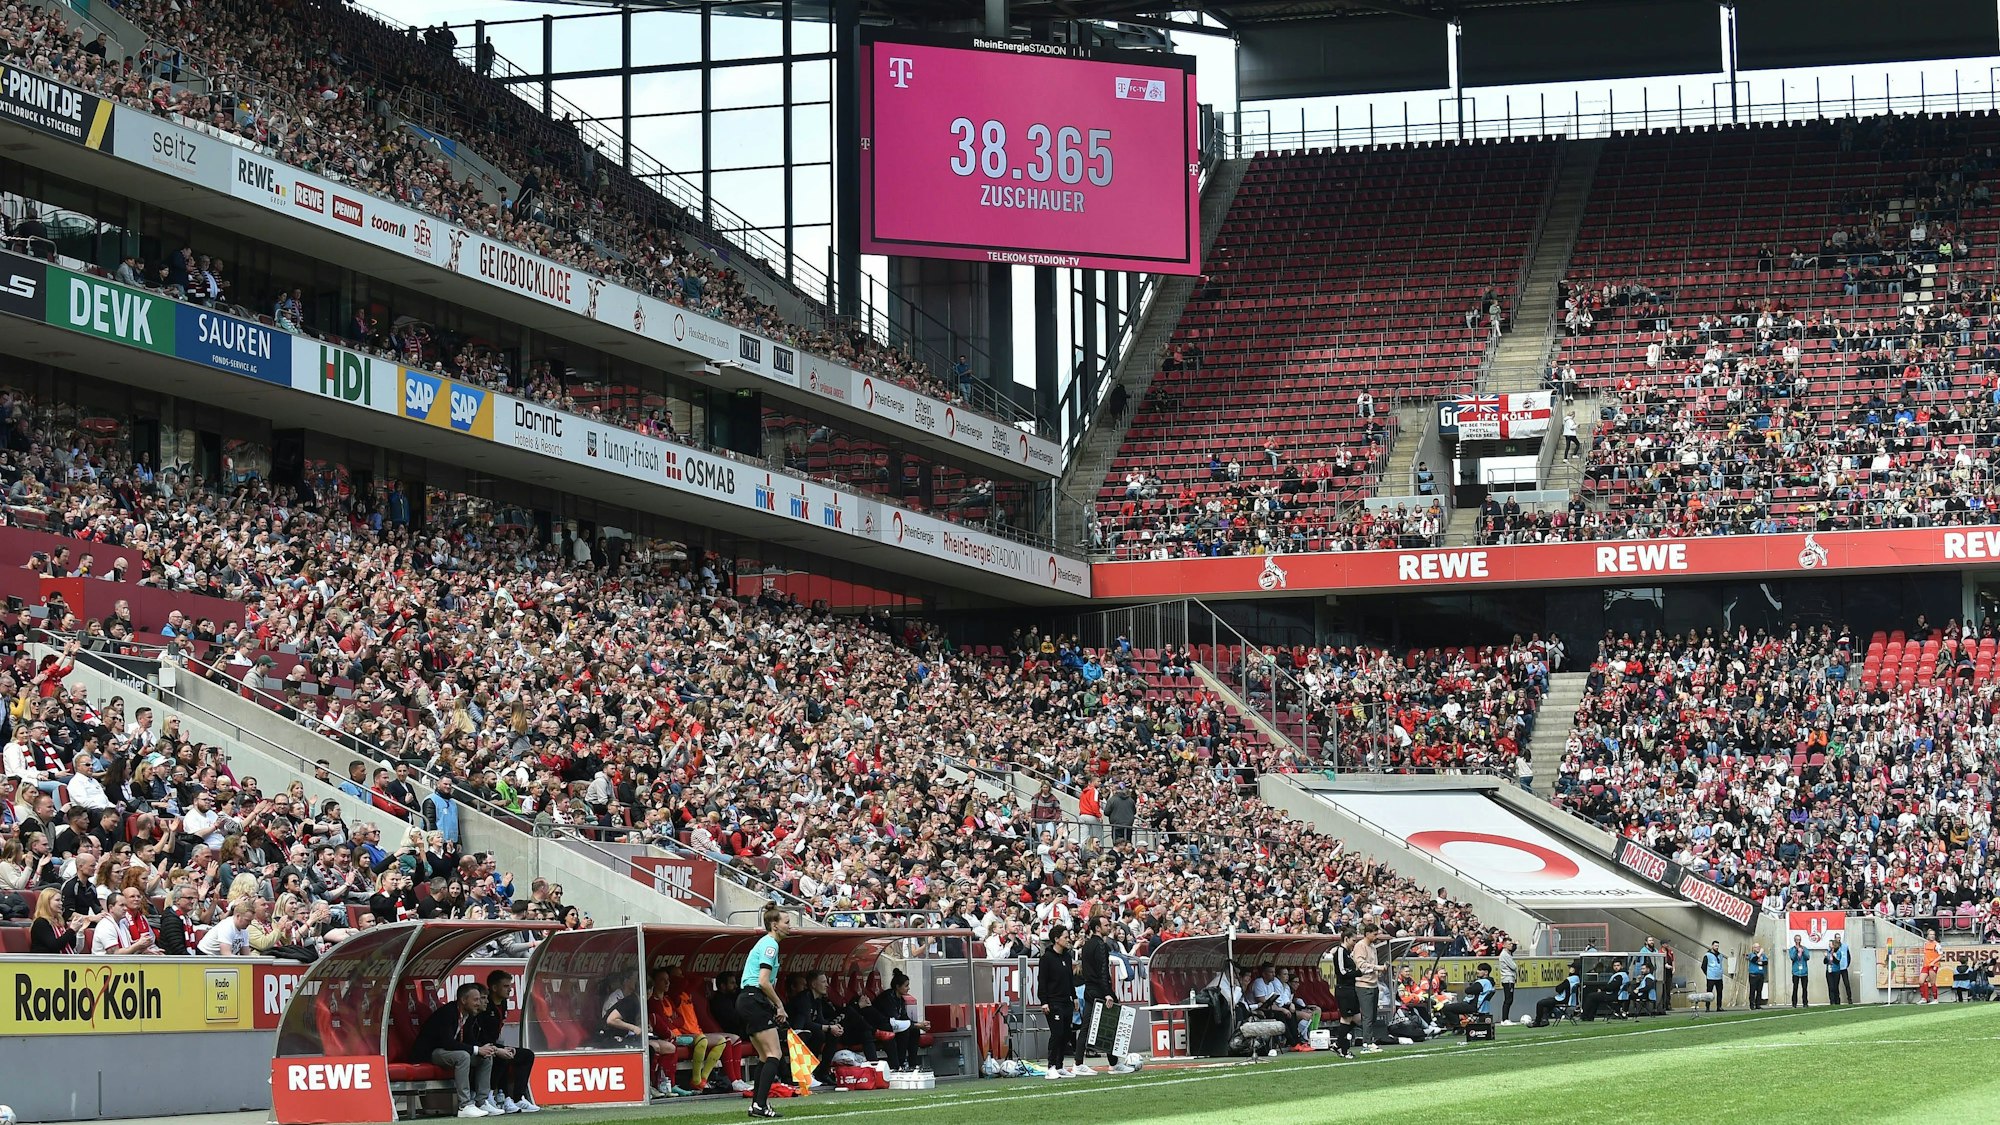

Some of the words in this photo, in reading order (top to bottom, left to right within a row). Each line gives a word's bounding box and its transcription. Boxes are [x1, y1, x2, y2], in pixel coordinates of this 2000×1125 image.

[973, 38, 1067, 56] RheinEnergieSTADION
[889, 57, 913, 88] T
[40, 115, 45, 125] &
[46, 117, 82, 138] STICKEREI
[152, 131, 197, 165] seitz
[950, 117, 1113, 187] 38.365
[238, 157, 275, 193] REWE
[295, 184, 324, 211] REWE
[980, 184, 1085, 213] ZUSCHAUER
[371, 213, 399, 236] toom
[413, 224, 432, 248] DER
[987, 251, 1027, 263] TELEKOM
[1028, 254, 1080, 266] STADION-TV
[479, 242, 571, 305] GEIßBOCKLOGE
[0, 275, 37, 299] S
[70, 277, 153, 344] DEVK
[198, 313, 271, 359] SAUREN
[741, 337, 760, 361] UTH
[774, 349, 793, 372] UTH
[212, 354, 250, 373] FONDS-SERVICE
[250, 363, 258, 374] AG
[319, 345, 371, 406] HDI
[405, 379, 434, 413] SAP
[451, 391, 478, 425] SAP
[875, 391, 905, 413] RheinEnergie
[916, 397, 932, 415] Rhein
[914, 409, 935, 430] Energie
[1476, 413, 1498, 421] 1.FC
[1501, 411, 1532, 421] KÖLN
[955, 420, 983, 441] RheinEnergie
[993, 425, 1008, 441] Rhein
[514, 431, 534, 449] Hotels
[540, 438, 563, 456] Resorts
[603, 432, 659, 472] funny-frisch
[992, 436, 1010, 456] Energie
[1028, 446, 1054, 466] RheinEnergie
[685, 457, 735, 495] OSMAB
[904, 524, 934, 545] RheinEnergie
[943, 531, 1021, 570] RheinEnergieSTADION
[1596, 543, 1688, 572] REWE
[1057, 567, 1083, 586] RheinEnergie
[1398, 551, 1489, 581] REWE
[1620, 841, 1667, 883] MATTES
[654, 864, 693, 900] REWE
[1680, 874, 1754, 927] UNBESIEGBAR
[693, 953, 724, 972] REWE
[789, 953, 818, 972] REWE
[819, 953, 847, 972] REWE
[215, 977, 230, 988] Radio
[15, 969, 95, 1021] Radio
[103, 970, 162, 1021] Köln
[217, 991, 228, 1001] Köln
[288, 1063, 372, 1091] REWE
[547, 1066, 626, 1093] REWE
